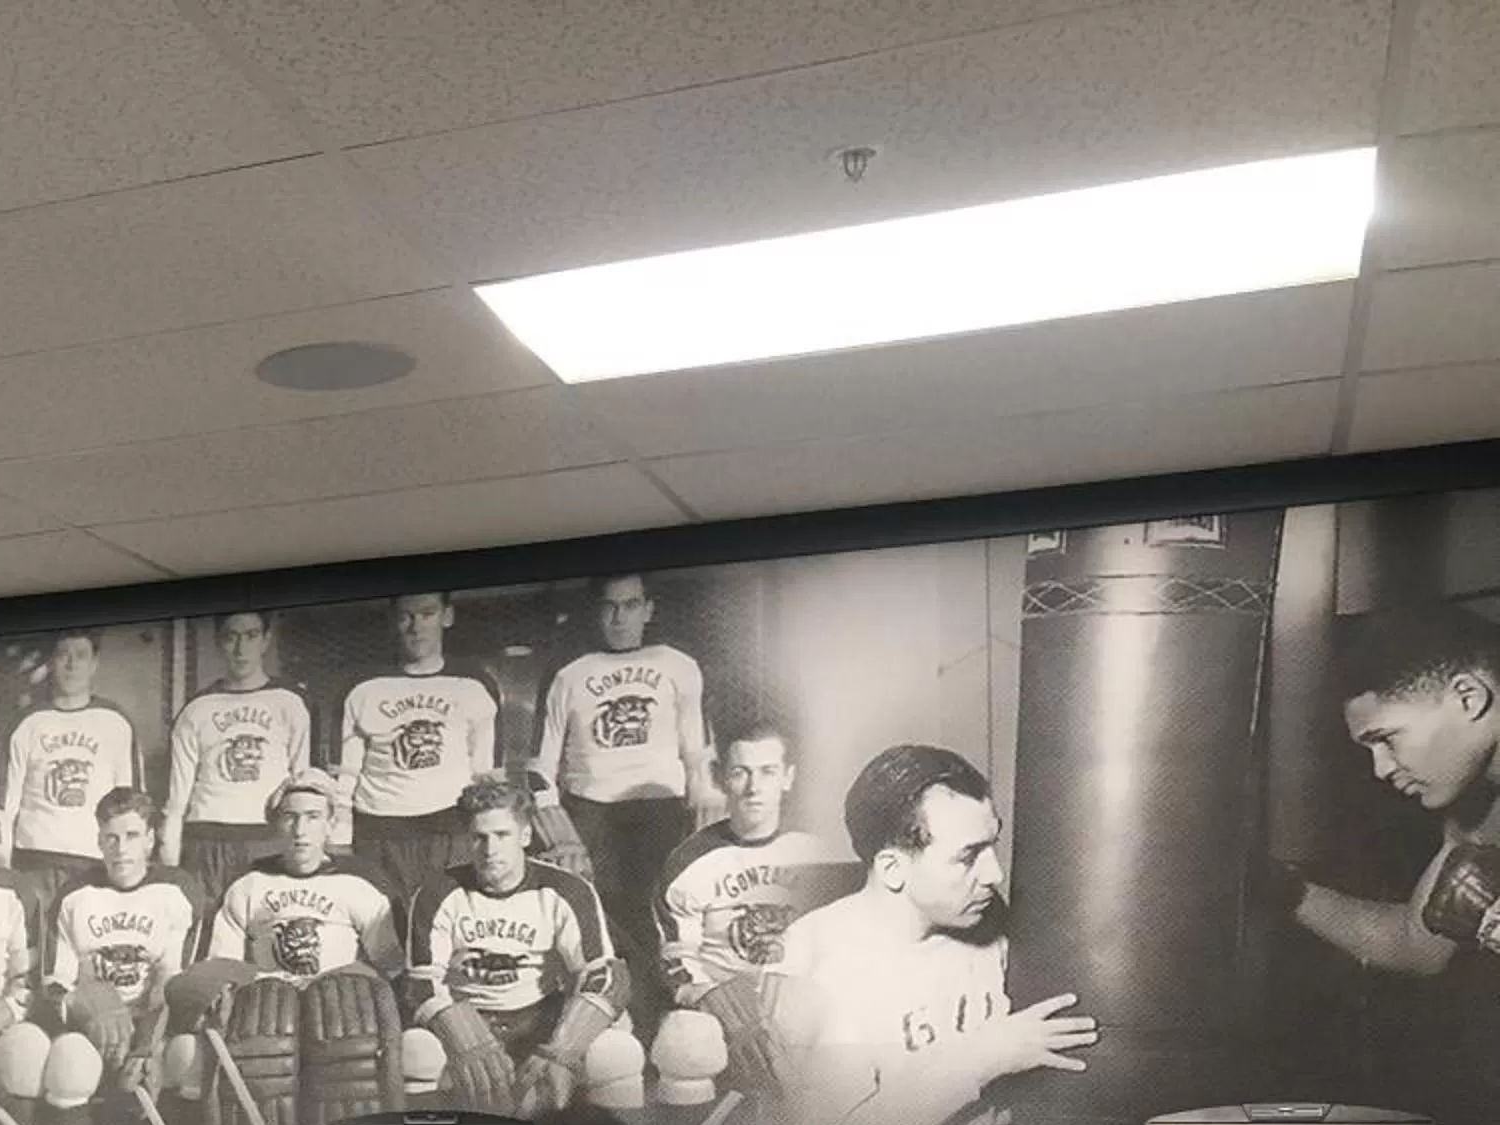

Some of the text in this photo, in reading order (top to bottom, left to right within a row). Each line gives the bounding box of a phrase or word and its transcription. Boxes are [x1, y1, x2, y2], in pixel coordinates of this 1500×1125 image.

[585, 666, 662, 698] GONZAGA
[211, 705, 273, 732] GONZAGA
[379, 693, 450, 720] GONZAGA
[265, 888, 336, 916] GONZAGA
[87, 911, 155, 938] GONZAGA
[458, 915, 538, 947] GONZAGA
